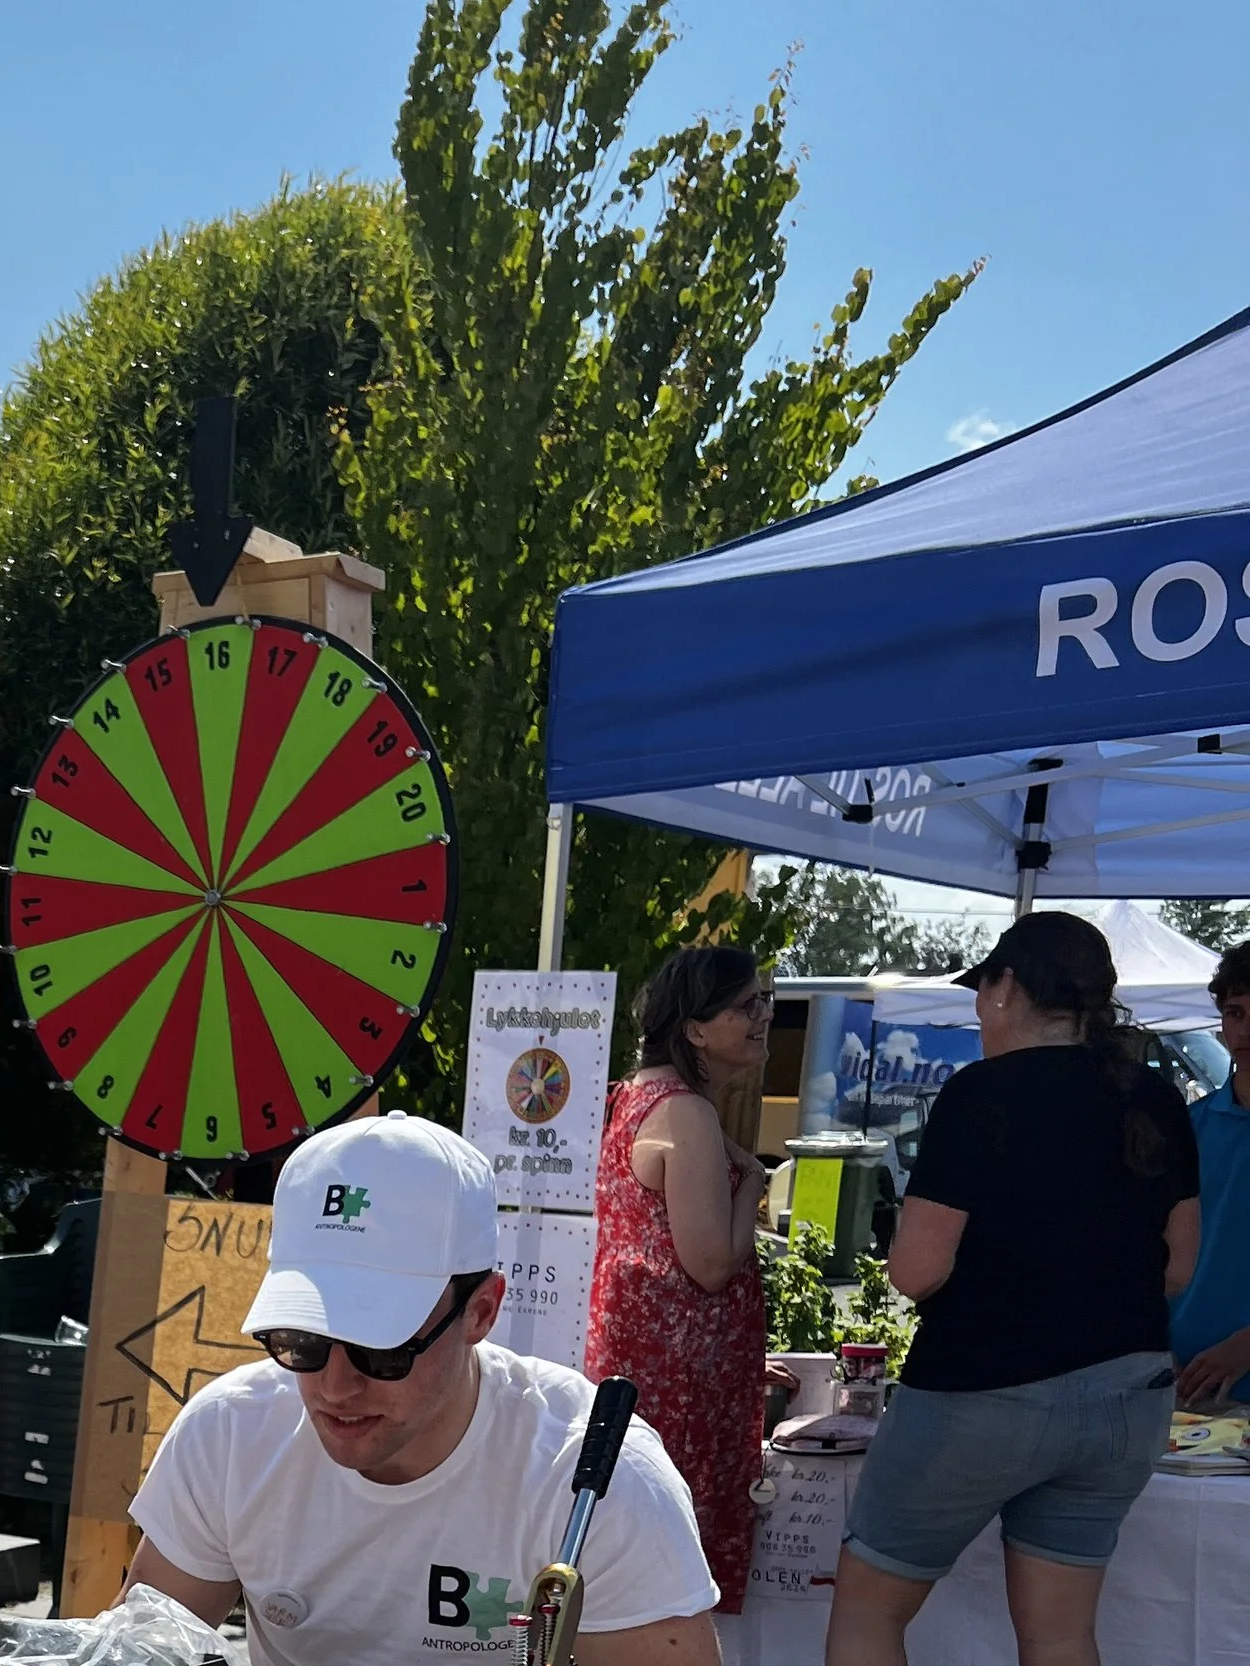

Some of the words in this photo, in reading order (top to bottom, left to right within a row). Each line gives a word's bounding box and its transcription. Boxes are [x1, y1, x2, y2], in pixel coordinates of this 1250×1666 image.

[204, 640, 231, 670] 16
[266, 646, 297, 677] 17
[143, 658, 173, 692] 15
[324, 670, 353, 707] 18
[92, 698, 122, 733] 14
[367, 720, 399, 755] 19
[51, 755, 78, 787] 13
[395, 783, 427, 822] 20
[29, 827, 53, 858] 12
[401, 879, 428, 895] 1
[21, 896, 42, 926] 11
[390, 949, 416, 969] 2
[30, 964, 53, 995] 10
[358, 1016, 383, 1039] 3
[486, 1007, 601, 1036] Lykkehjulet
[57, 1026, 78, 1048] 9
[97, 1075, 115, 1097] 8
[315, 1074, 332, 1098] 4
[146, 1104, 163, 1129] 7
[205, 1115, 218, 1141] 6
[261, 1102, 277, 1129] 5
[494, 1154, 517, 1174] pr.
[522, 1154, 573, 1176] spinn
[165, 1205, 272, 1259] SNU
[498, 1261, 557, 1283] IPPS
[530, 1289, 558, 1305] 990
[765, 1530, 810, 1544] VIPPS
[751, 1569, 801, 1585] OLEN
[428, 1563, 471, 1627] B
[422, 1637, 515, 1651] ANTROPOLOGE
